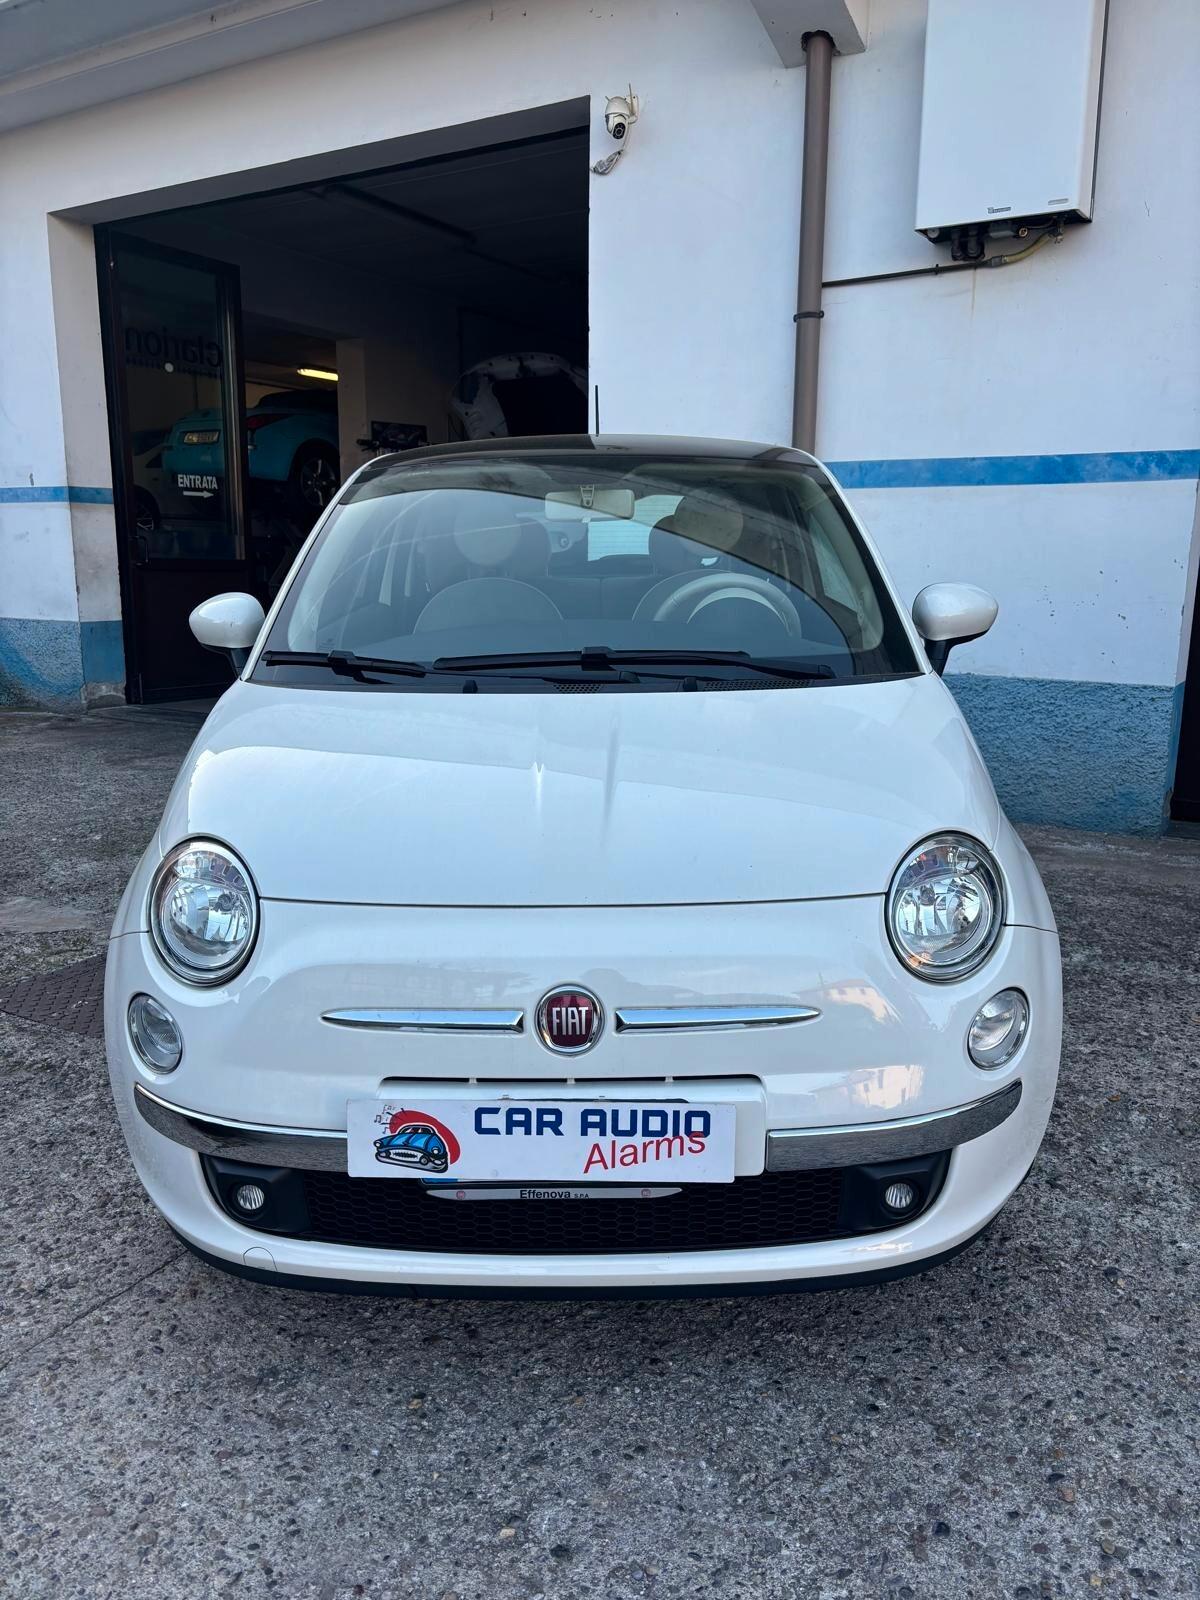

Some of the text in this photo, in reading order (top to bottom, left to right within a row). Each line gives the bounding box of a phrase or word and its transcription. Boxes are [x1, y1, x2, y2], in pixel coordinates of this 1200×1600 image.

[177, 474, 219, 490] ENTRATA
[552, 1006, 589, 1035] FIAT
[474, 1106, 711, 1138] CAR AUDIO
[583, 1131, 707, 1174] Alarms
[519, 1189, 571, 1199] Effenova
